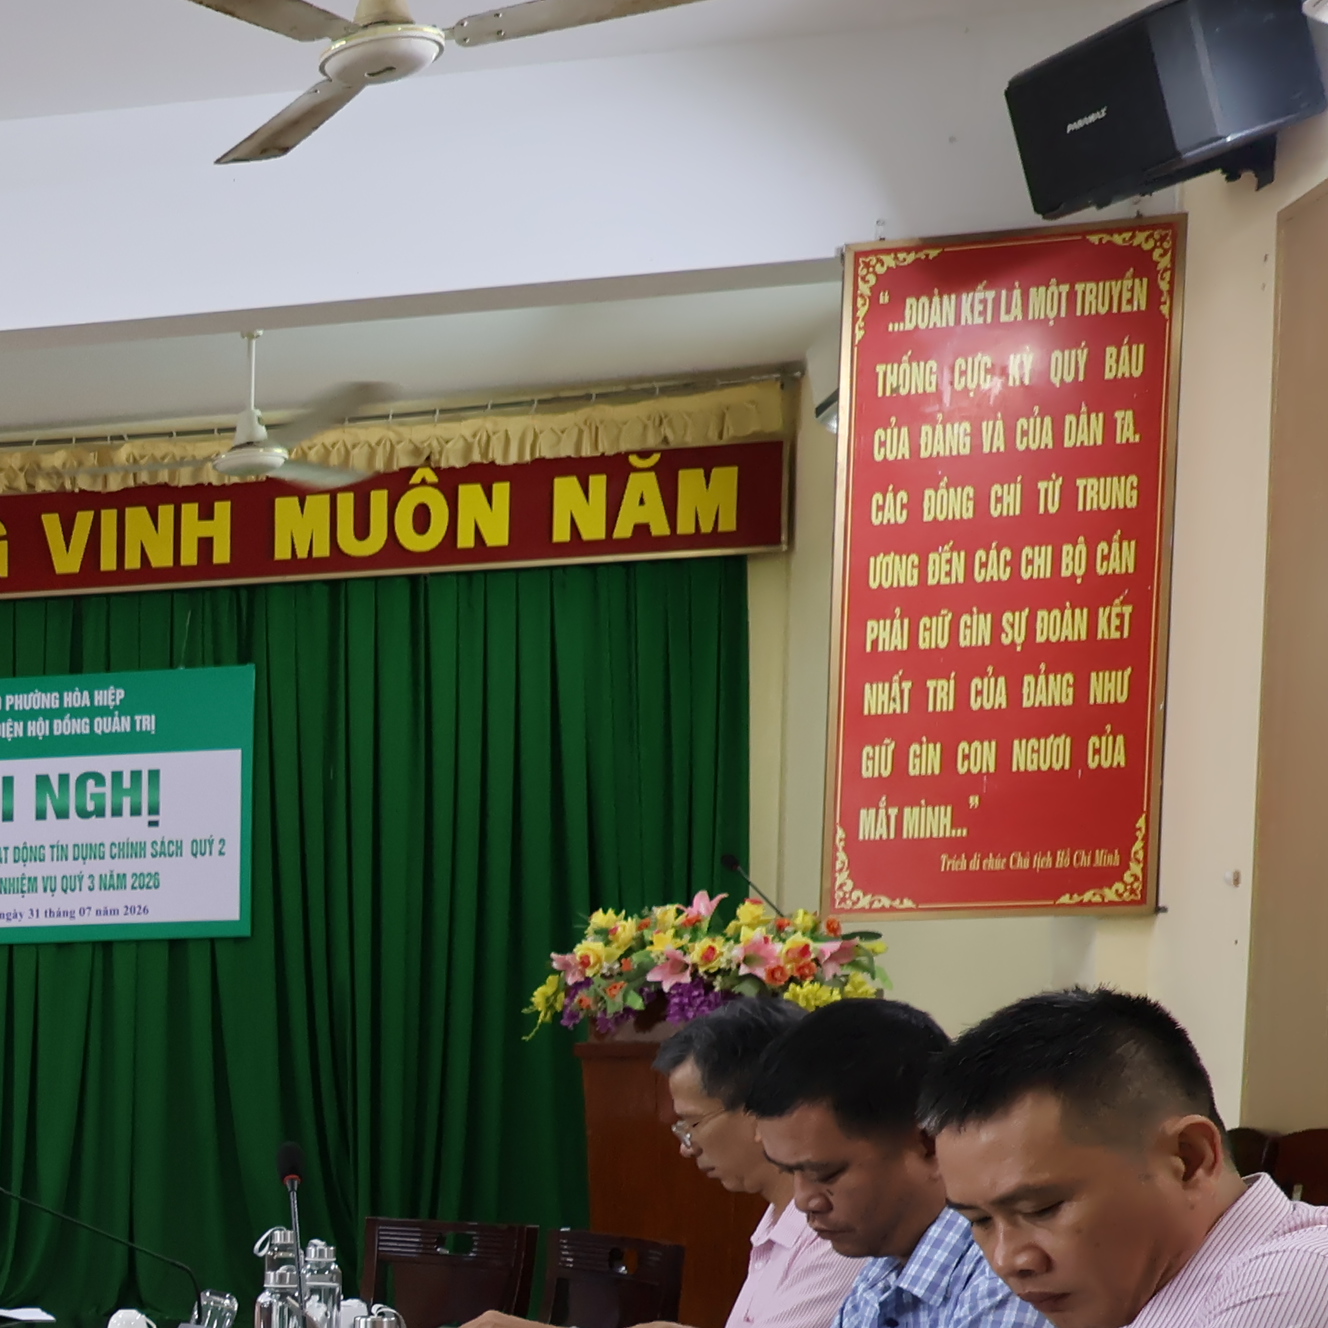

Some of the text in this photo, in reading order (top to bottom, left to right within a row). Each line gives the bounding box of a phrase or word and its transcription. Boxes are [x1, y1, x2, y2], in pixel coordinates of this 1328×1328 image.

[999, 281, 1022, 322] LÀ
[1028, 278, 1069, 326] MỘT
[873, 416, 909, 461] CỦA
[919, 413, 970, 458] ĐẢNG
[981, 412, 1004, 453] VÀ
[1015, 405, 1053, 451] CỦA
[1113, 409, 1140, 444] TA.
[41, 500, 232, 575] VINH
[274, 467, 511, 560] MUÔN
[552, 453, 739, 543] NĂM
[870, 483, 908, 525] CÁC
[989, 475, 1021, 517] CHÍ
[1037, 472, 1062, 514] TỪ
[1075, 474, 1138, 511] TRUNG
[868, 551, 919, 589] ƯƠNG
[927, 540, 965, 585] ĐẾN
[973, 541, 1011, 582] CÁC
[1020, 544, 1052, 580] CHI
[1060, 535, 1086, 584] BỘ
[865, 606, 909, 652] PHẢI
[918, 608, 952, 649] GIỮ
[958, 606, 991, 647] GÌN
[1000, 607, 1029, 651] SỰ
[1035, 601, 1088, 643] ĐOÀN
[5, 689, 59, 710] PHƯỜNG
[63, 687, 90, 707] HÒA
[94, 686, 124, 708] HIỆP
[863, 661, 1131, 715] NHẤT TRÍ CỦA ĐẢNG NHƯ
[27, 717, 49, 739] HỘI
[53, 713, 89, 735] ĐỒNG
[94, 711, 130, 734] QUẢN
[134, 714, 155, 733] TRỊ
[34, 768, 160, 827] NGHỊ
[858, 795, 898, 840] MẮT
[12, 841, 45, 866] ĐỘNG
[49, 841, 68, 861] TÍN
[72, 841, 105, 864] DỤNG
[109, 838, 146, 860] CHÍNH
[150, 836, 183, 858] SÁCH
[190, 834, 214, 858] QUÝ
[218, 837, 225, 856] 2
[41, 875, 57, 896] VỤ
[60, 870, 84, 894] QUÝ
[87, 873, 95, 891] 3
[98, 869, 127, 891] NĂM
[130, 871, 160, 890] 2026
